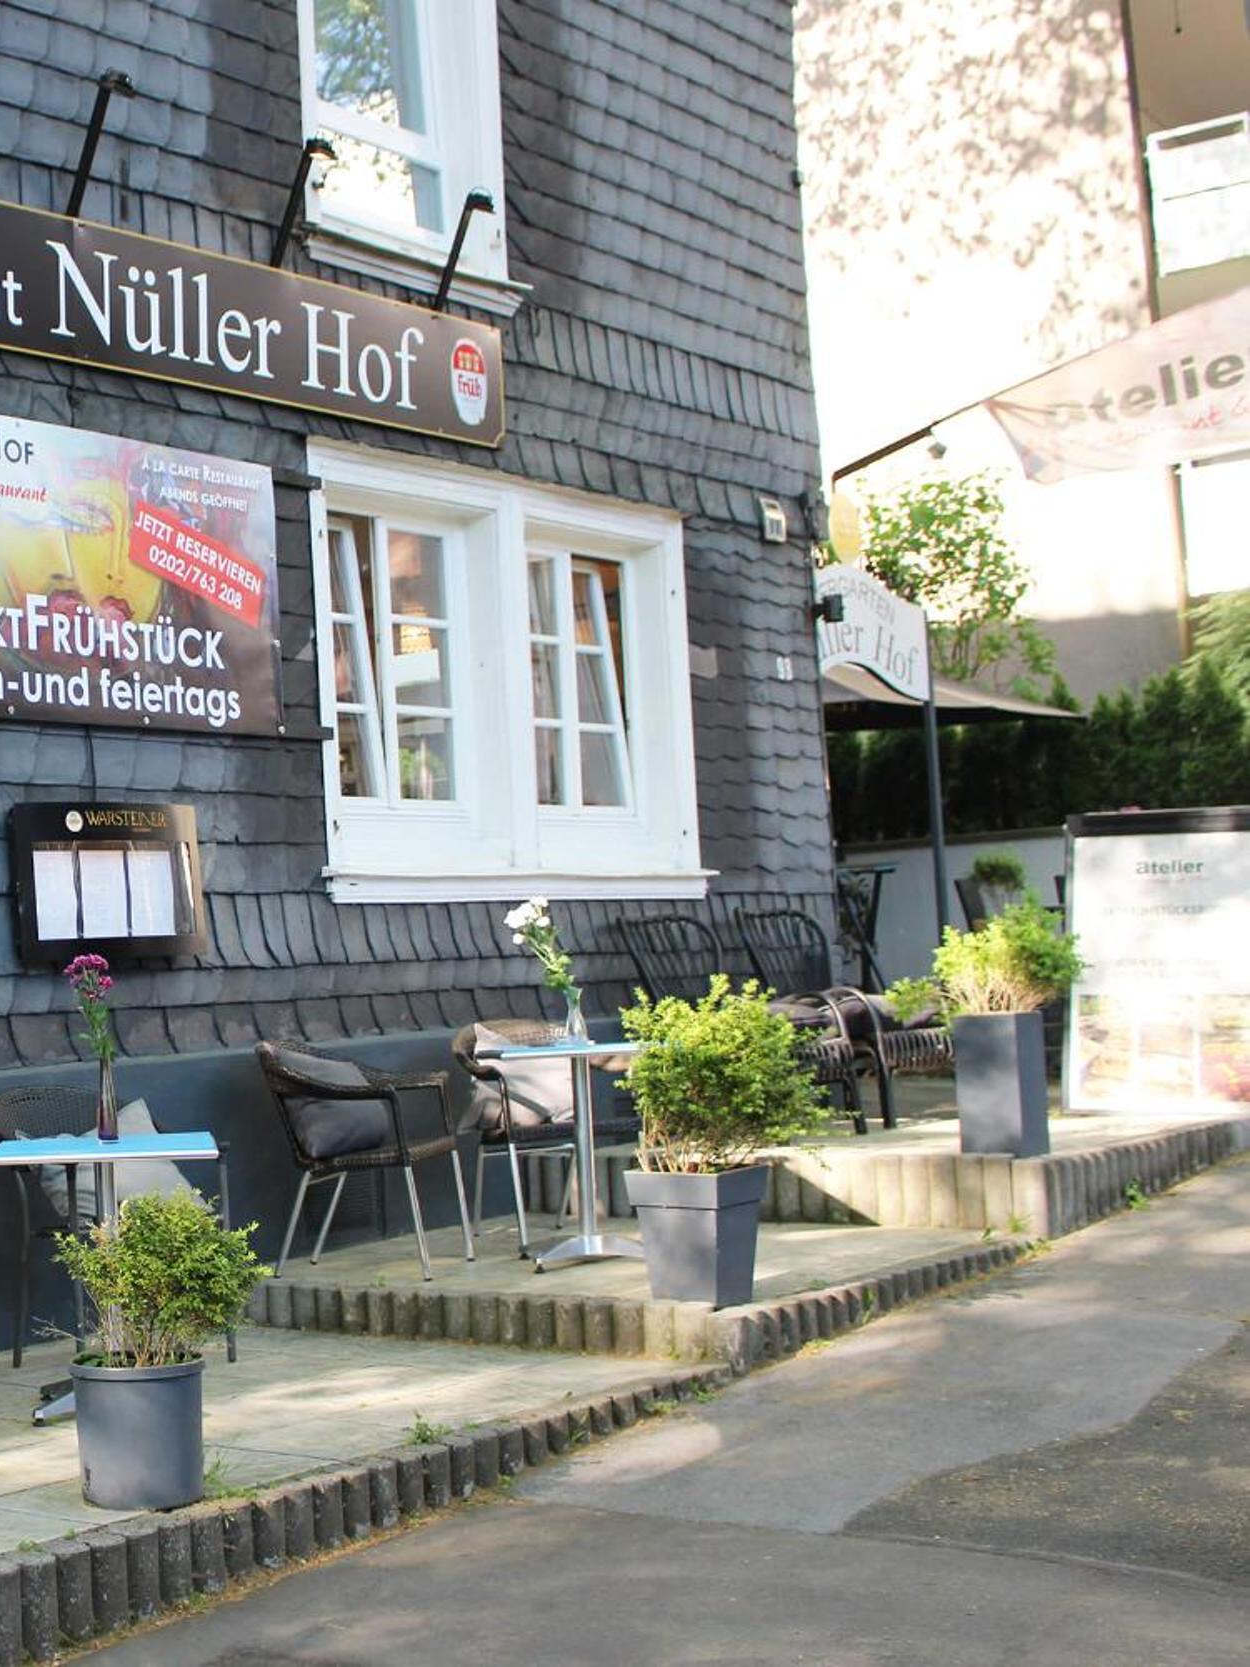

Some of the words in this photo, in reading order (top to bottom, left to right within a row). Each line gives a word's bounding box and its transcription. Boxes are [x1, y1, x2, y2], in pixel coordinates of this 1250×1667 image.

[46, 240, 282, 379] Nüller
[300, 301, 425, 410] Hof
[153, 460, 165, 473] LA
[169, 463, 200, 481] CARTE
[159, 486, 199, 504] ABENDS
[135, 511, 174, 543] JETZT
[175, 532, 261, 595] RESERVIEREN
[149, 545, 216, 594] 0202/763
[218, 582, 243, 610] 208
[875, 625, 919, 685] Hof
[100, 667, 241, 728] feiertags
[84, 810, 166, 828] WARSTEINER
[1136, 859, 1205, 876] atelier
